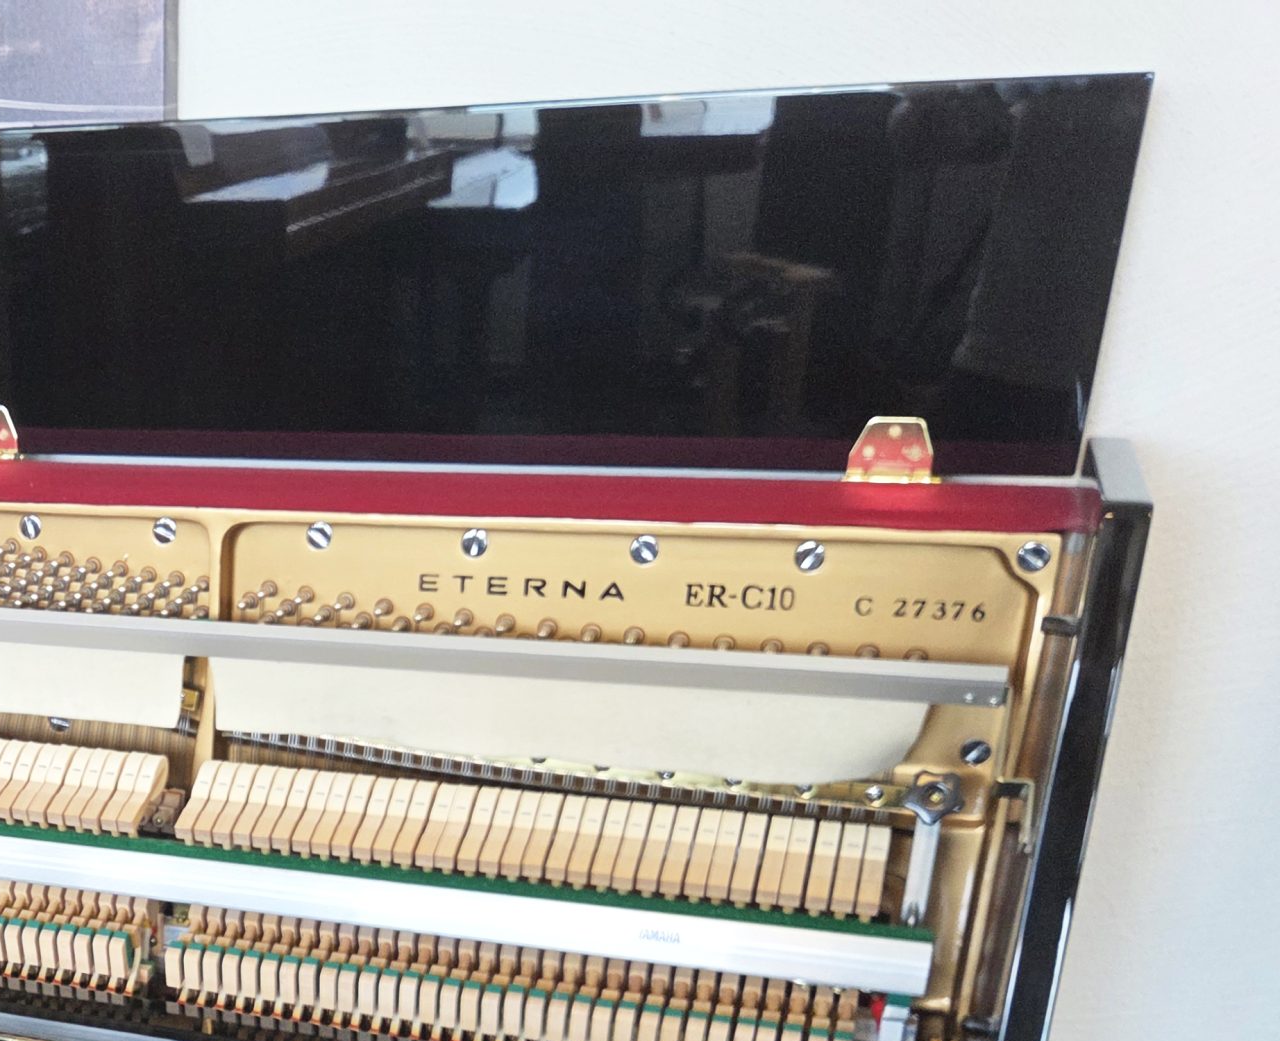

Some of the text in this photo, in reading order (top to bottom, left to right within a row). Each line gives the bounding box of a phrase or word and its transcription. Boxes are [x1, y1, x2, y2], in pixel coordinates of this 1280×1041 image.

[418, 573, 625, 601] ETERNA
[685, 583, 796, 611] ER-C10
[854, 597, 987, 623] C 27376
